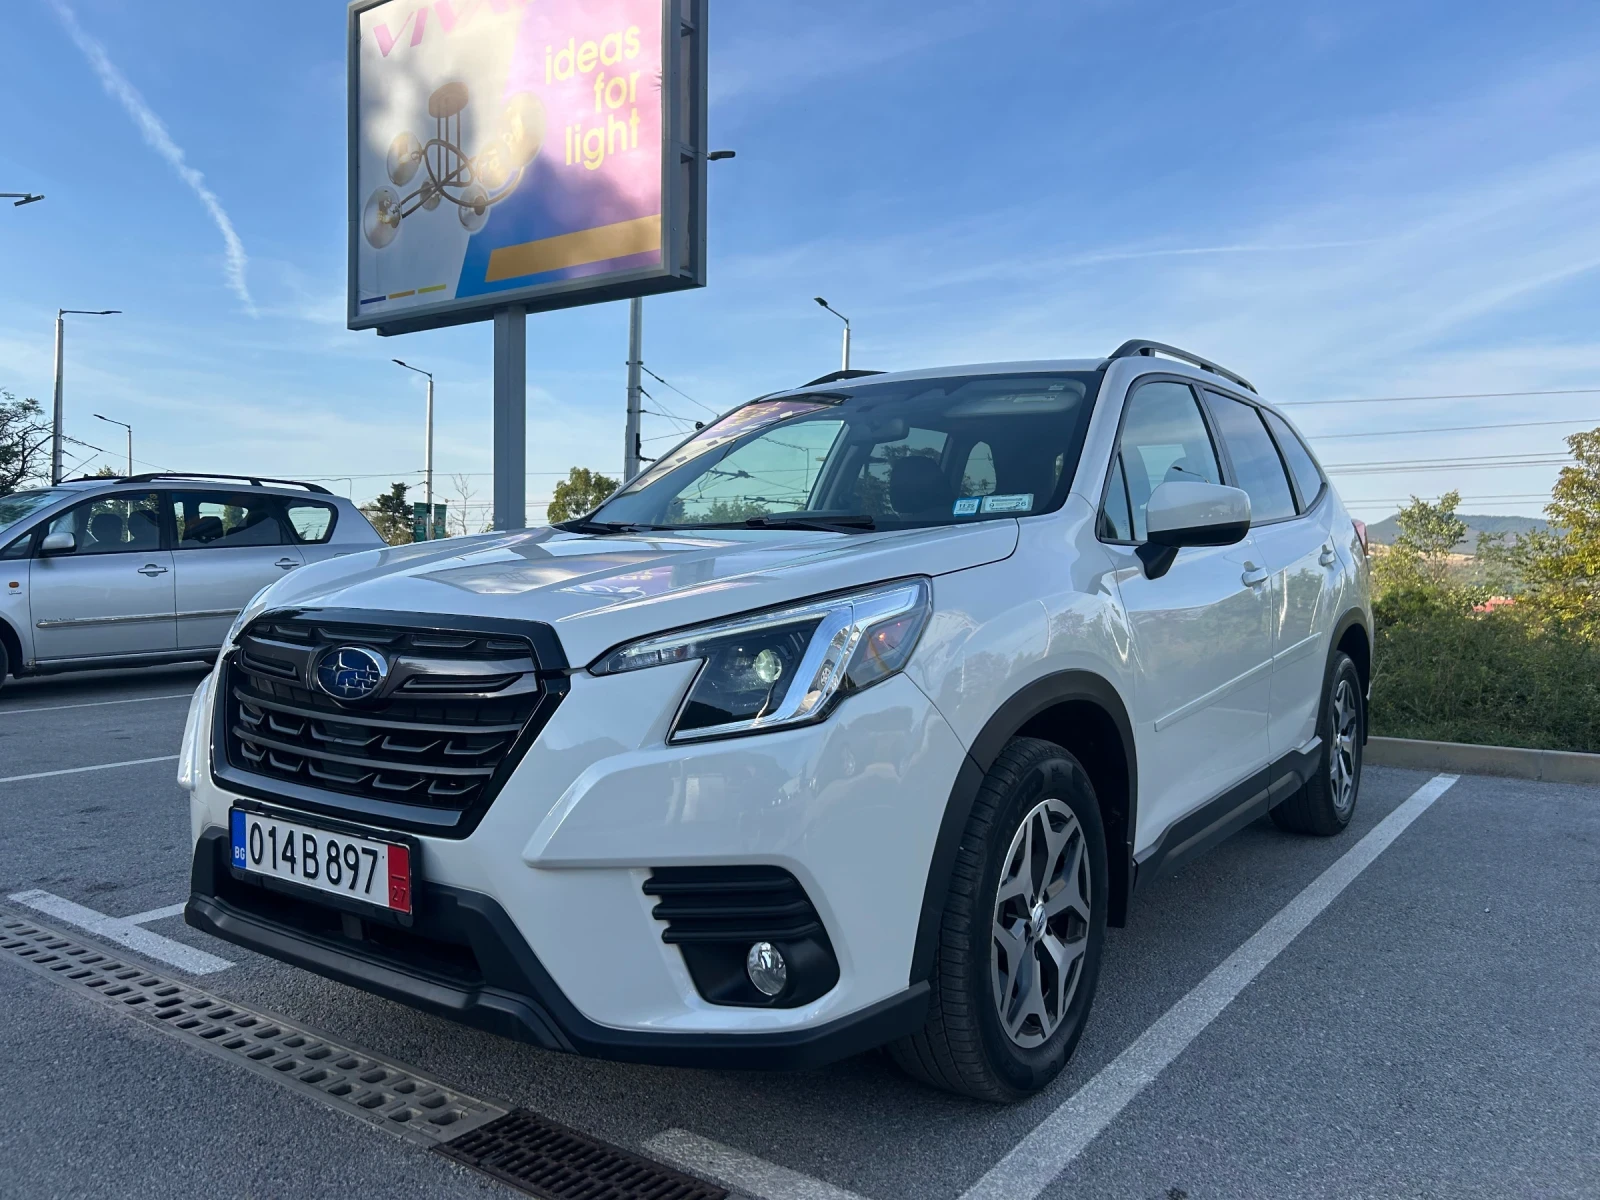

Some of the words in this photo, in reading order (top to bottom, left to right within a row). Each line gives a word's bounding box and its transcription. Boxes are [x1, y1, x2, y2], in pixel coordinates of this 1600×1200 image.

[545, 25, 640, 84] ideas
[594, 70, 640, 113] for
[565, 107, 640, 171] light
[234, 846, 246, 860] BG
[392, 885, 406, 903] 27
